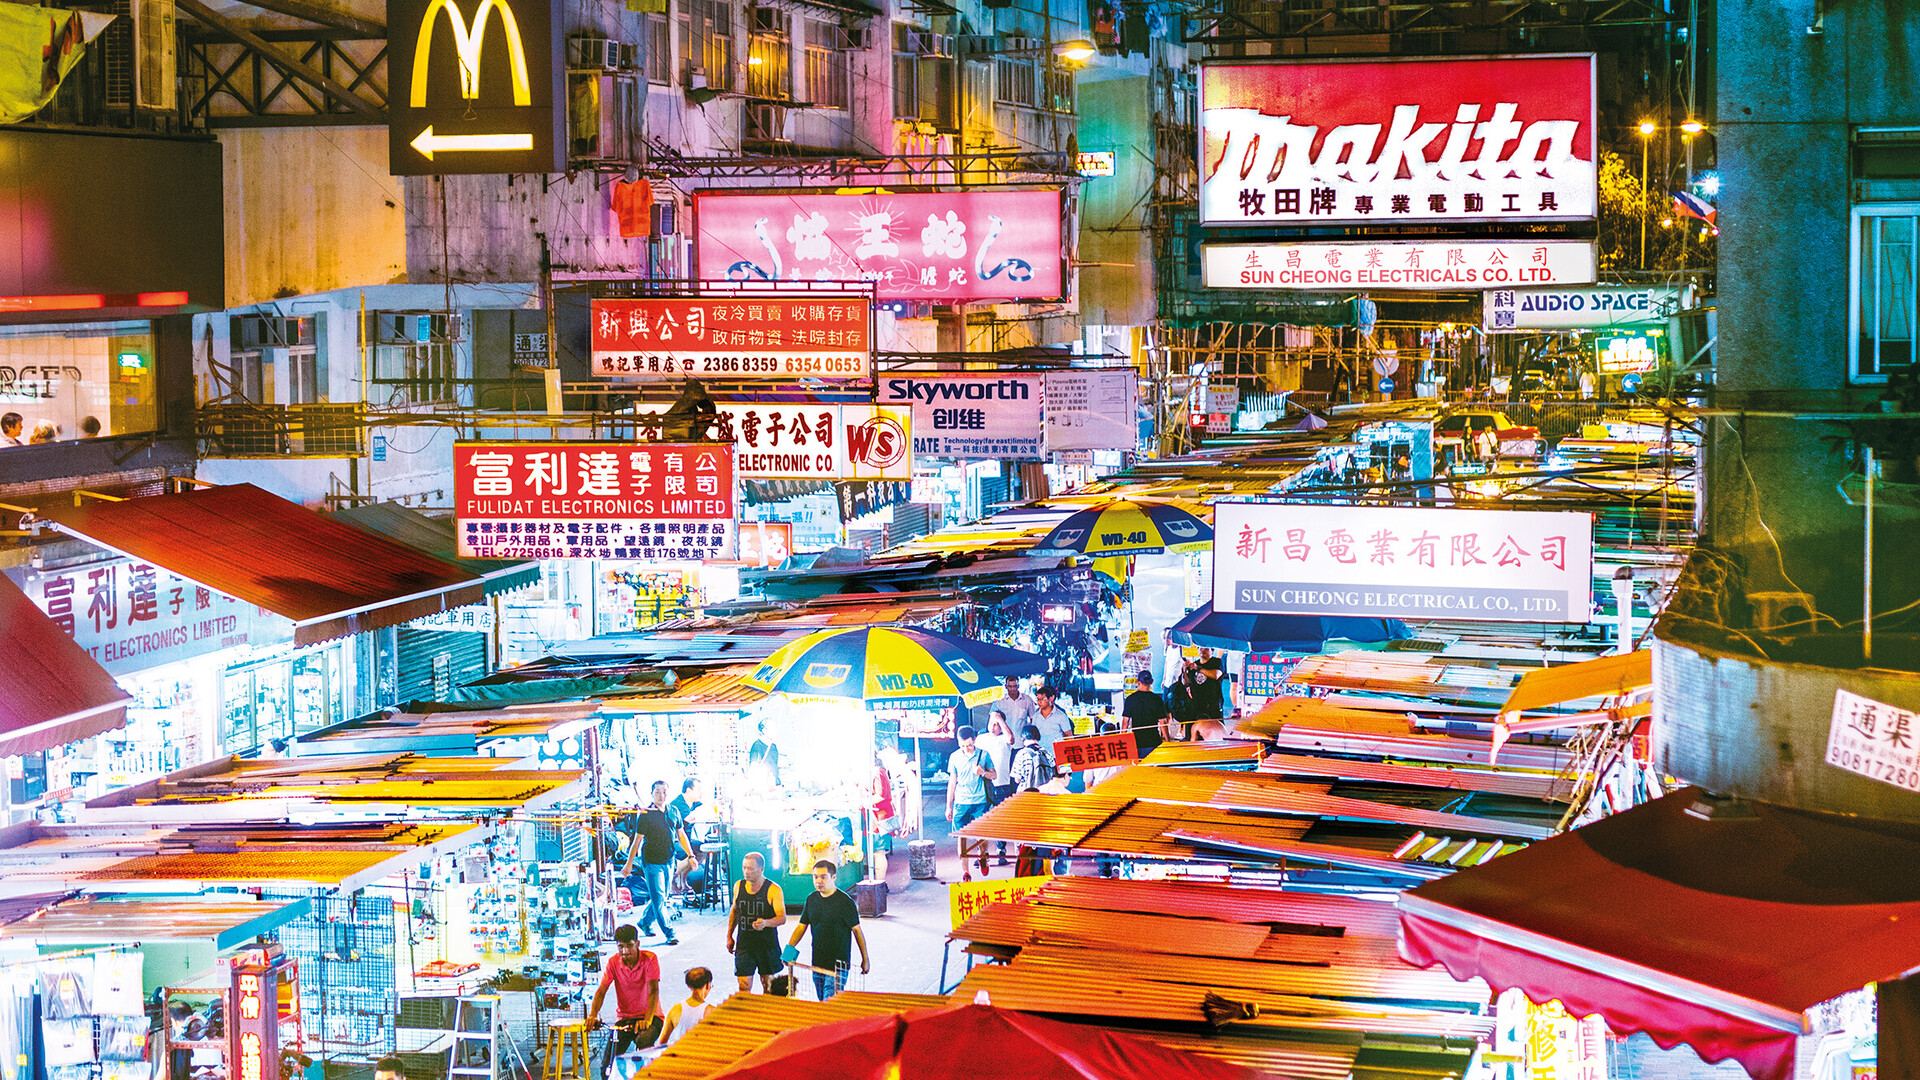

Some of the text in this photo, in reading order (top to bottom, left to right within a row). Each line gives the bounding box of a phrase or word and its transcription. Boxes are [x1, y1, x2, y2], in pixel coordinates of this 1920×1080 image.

[1239, 188, 1558, 215] 牧田牌 專業電動工具
[1245, 247, 1549, 269] 生昌電業有限公司
[1240, 268, 1557, 283] SUN CHEONG ELECTRICALS CO. LTD.
[1590, 293, 1649, 311] SPACE
[599, 307, 704, 341] 新興公司
[712, 305, 862, 322] 夜冷買賣 收購存貨
[712, 329, 862, 346] 政府物資 法院封存
[703, 357, 739, 372] 2386
[742, 357, 778, 372] 8359
[785, 357, 821, 372] 6354
[825, 357, 862, 372] 0653
[888, 380, 1029, 404] Skyworth
[932, 408, 985, 430] 创维
[472, 451, 621, 496] 富利達
[739, 453, 835, 472] ELECTRONIC CO.
[467, 499, 726, 515] FULIDAT ELECTRONICS LIMITED
[1101, 531, 1147, 546] WD-40
[1236, 523, 1567, 571] 新昌電業有限公司
[1241, 588, 1561, 613] SUN CHEONG ELECTRICAL CO., LTD.
[104, 625, 188, 663] ELECTRONICS
[193, 615, 236, 641] LIMITED
[809, 664, 848, 680] WD-40
[875, 672, 934, 692] WD-40
[1848, 702, 1912, 749] 通渠
[1064, 740, 1128, 765] 電話咭
[1831, 746, 1919, 788] 90817280
